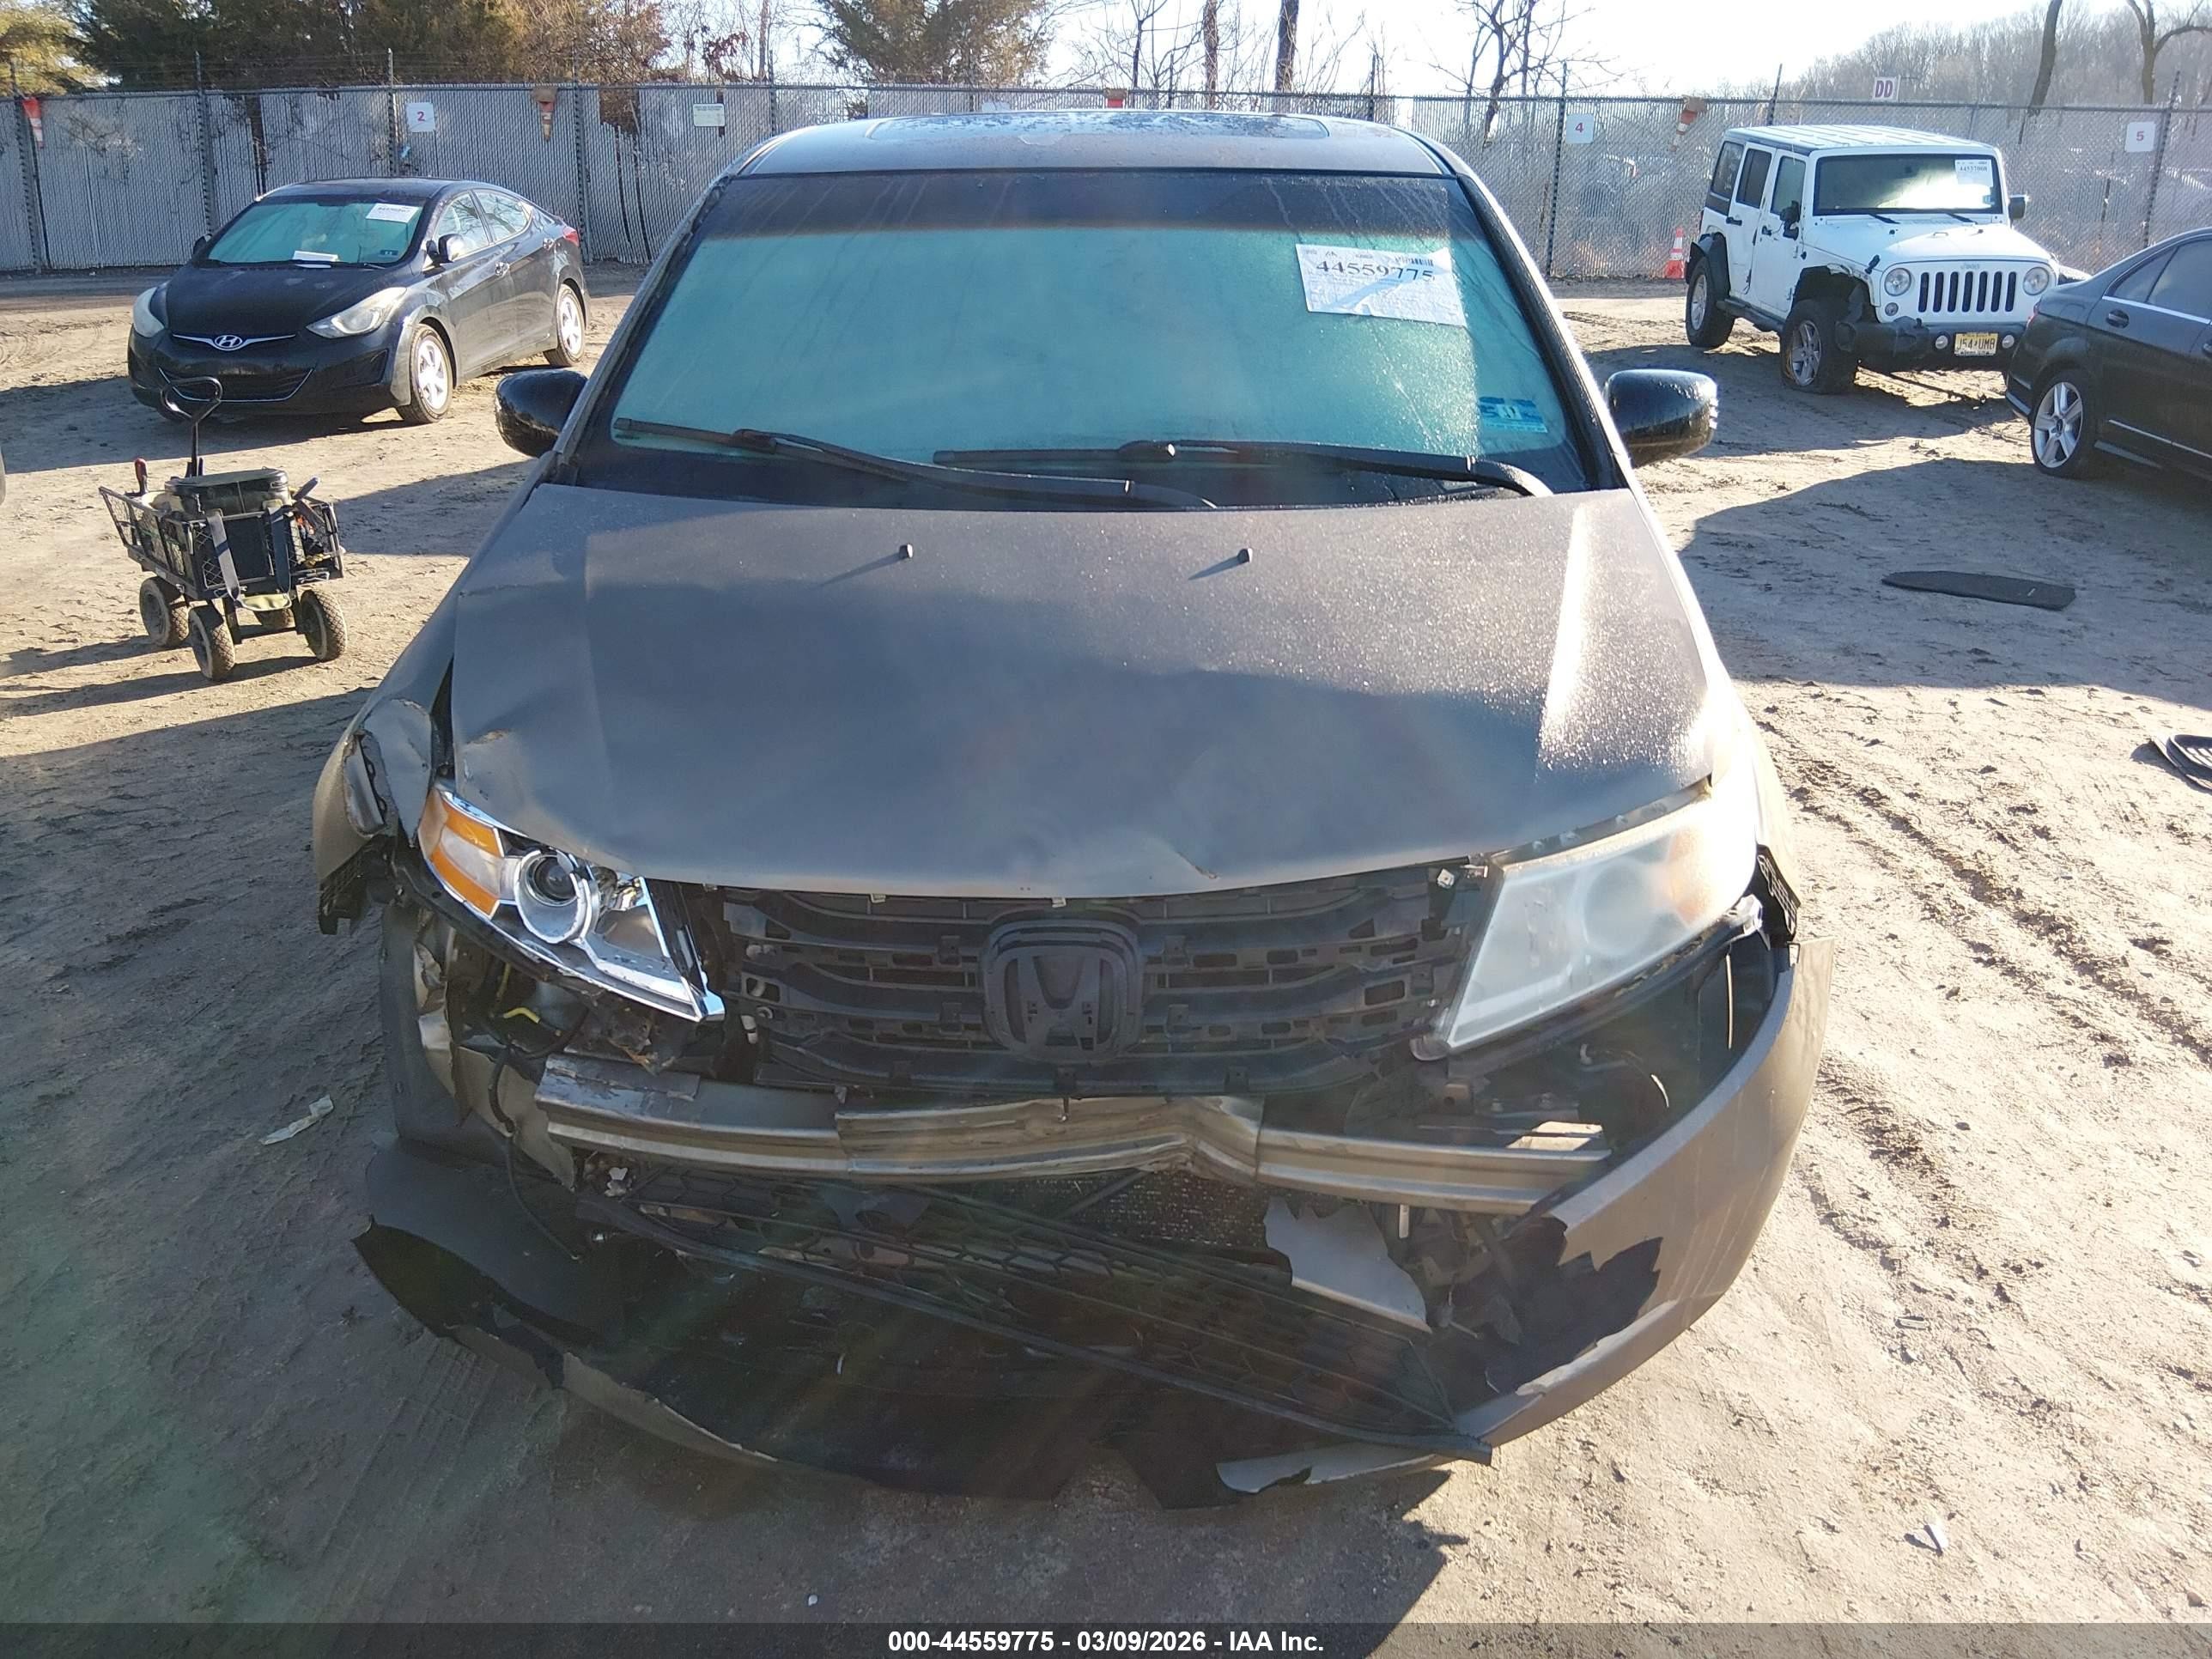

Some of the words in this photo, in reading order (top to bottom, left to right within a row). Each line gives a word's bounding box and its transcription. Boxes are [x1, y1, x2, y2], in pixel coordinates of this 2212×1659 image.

[1875, 80, 1893, 98] DD
[416, 111, 425, 122] 2
[1575, 122, 1584, 133] 4
[2136, 131, 2144, 142] 5
[1316, 260, 1435, 283] 44559775
